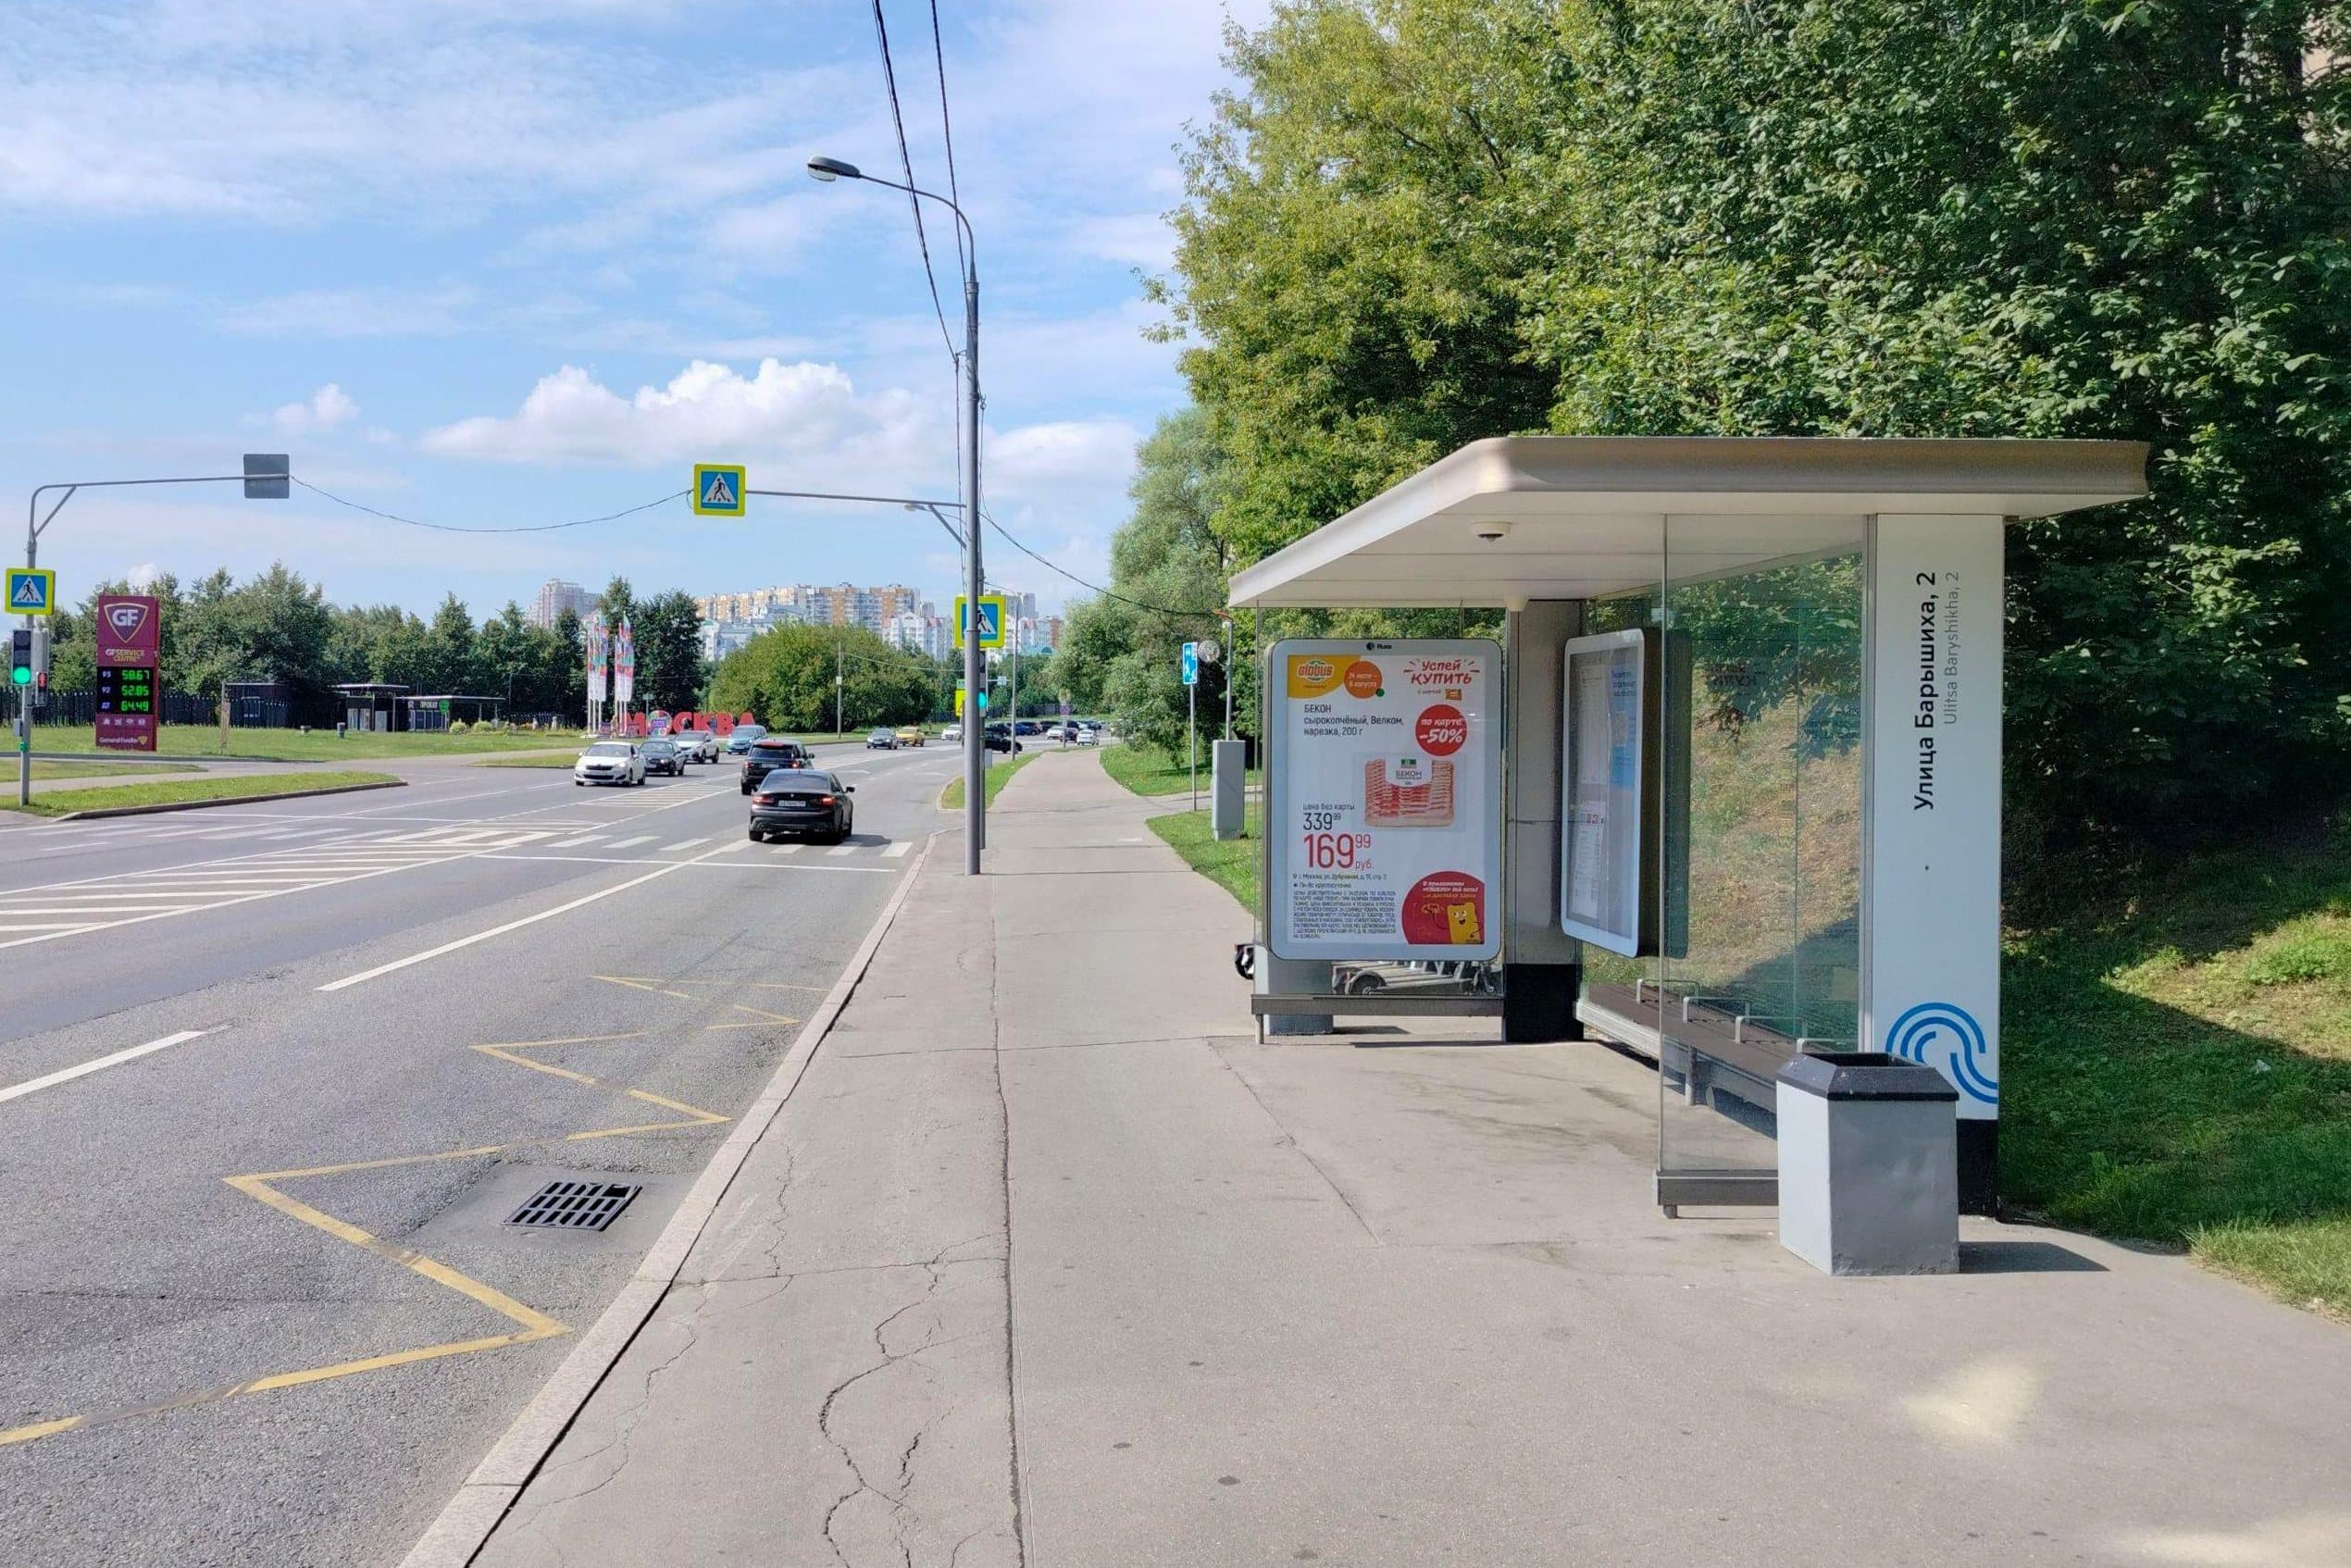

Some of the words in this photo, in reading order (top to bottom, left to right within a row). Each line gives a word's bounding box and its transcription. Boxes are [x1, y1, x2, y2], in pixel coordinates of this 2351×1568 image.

[1916, 571, 1936, 586] 2
[1946, 571, 1959, 581] 2
[112, 609, 139, 627] GF
[1944, 586, 1960, 677] Baryshikha,
[1914, 593, 1939, 728] Барышиха,
[1411, 673, 1473, 686] КУПИТЬ
[1304, 703, 1332, 714] БЕКОН
[1944, 680, 1958, 725] Ulitsa
[1342, 727, 1357, 736] 200
[1419, 728, 1463, 743] -50%
[1913, 737, 1936, 811] Улица
[1303, 813, 1333, 830] 339
[1303, 833, 1354, 869] 169
[1355, 833, 1371, 849] 99
